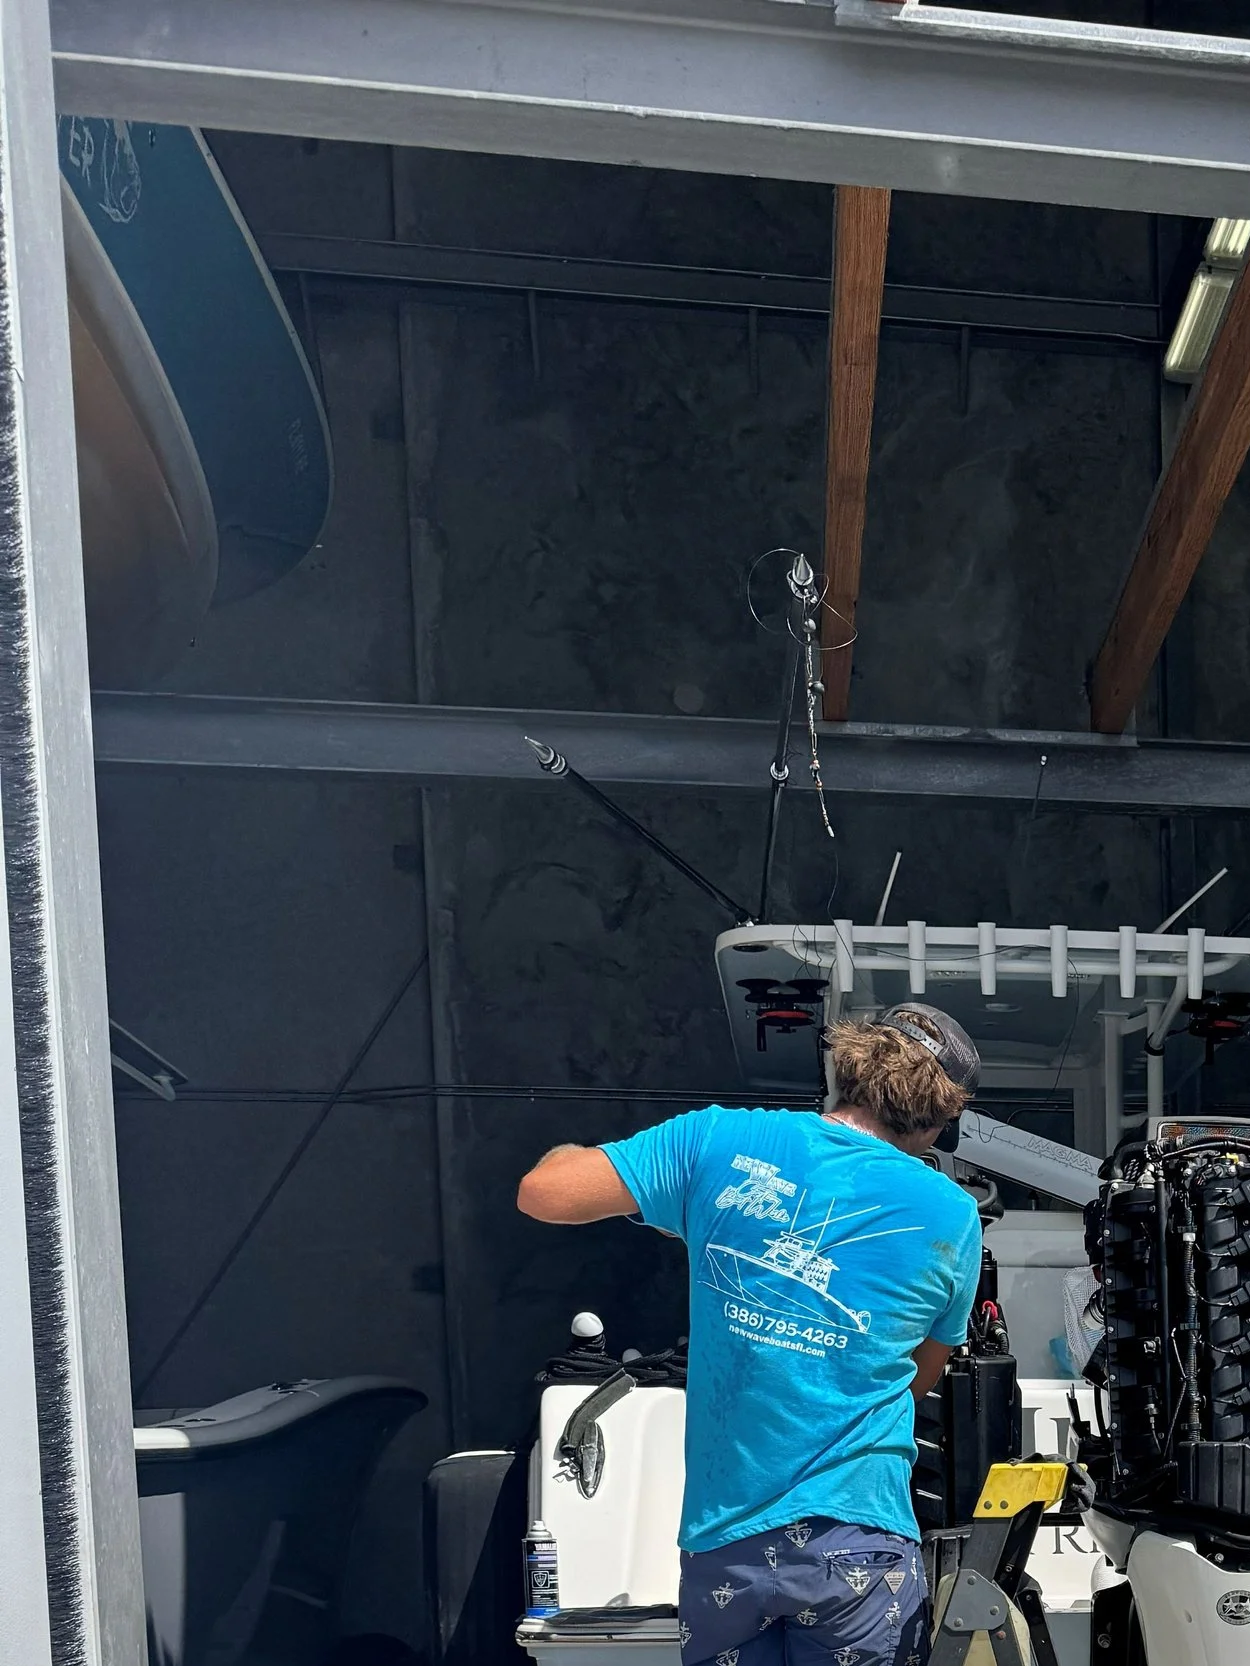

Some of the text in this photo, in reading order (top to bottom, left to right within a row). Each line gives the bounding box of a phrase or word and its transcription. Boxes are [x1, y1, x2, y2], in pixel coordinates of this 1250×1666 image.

[1027, 1136, 1093, 1171] MAGMA
[723, 1301, 848, 1349] (386)795-4263
[728, 1323, 826, 1358] newwaveboatsfl.com
